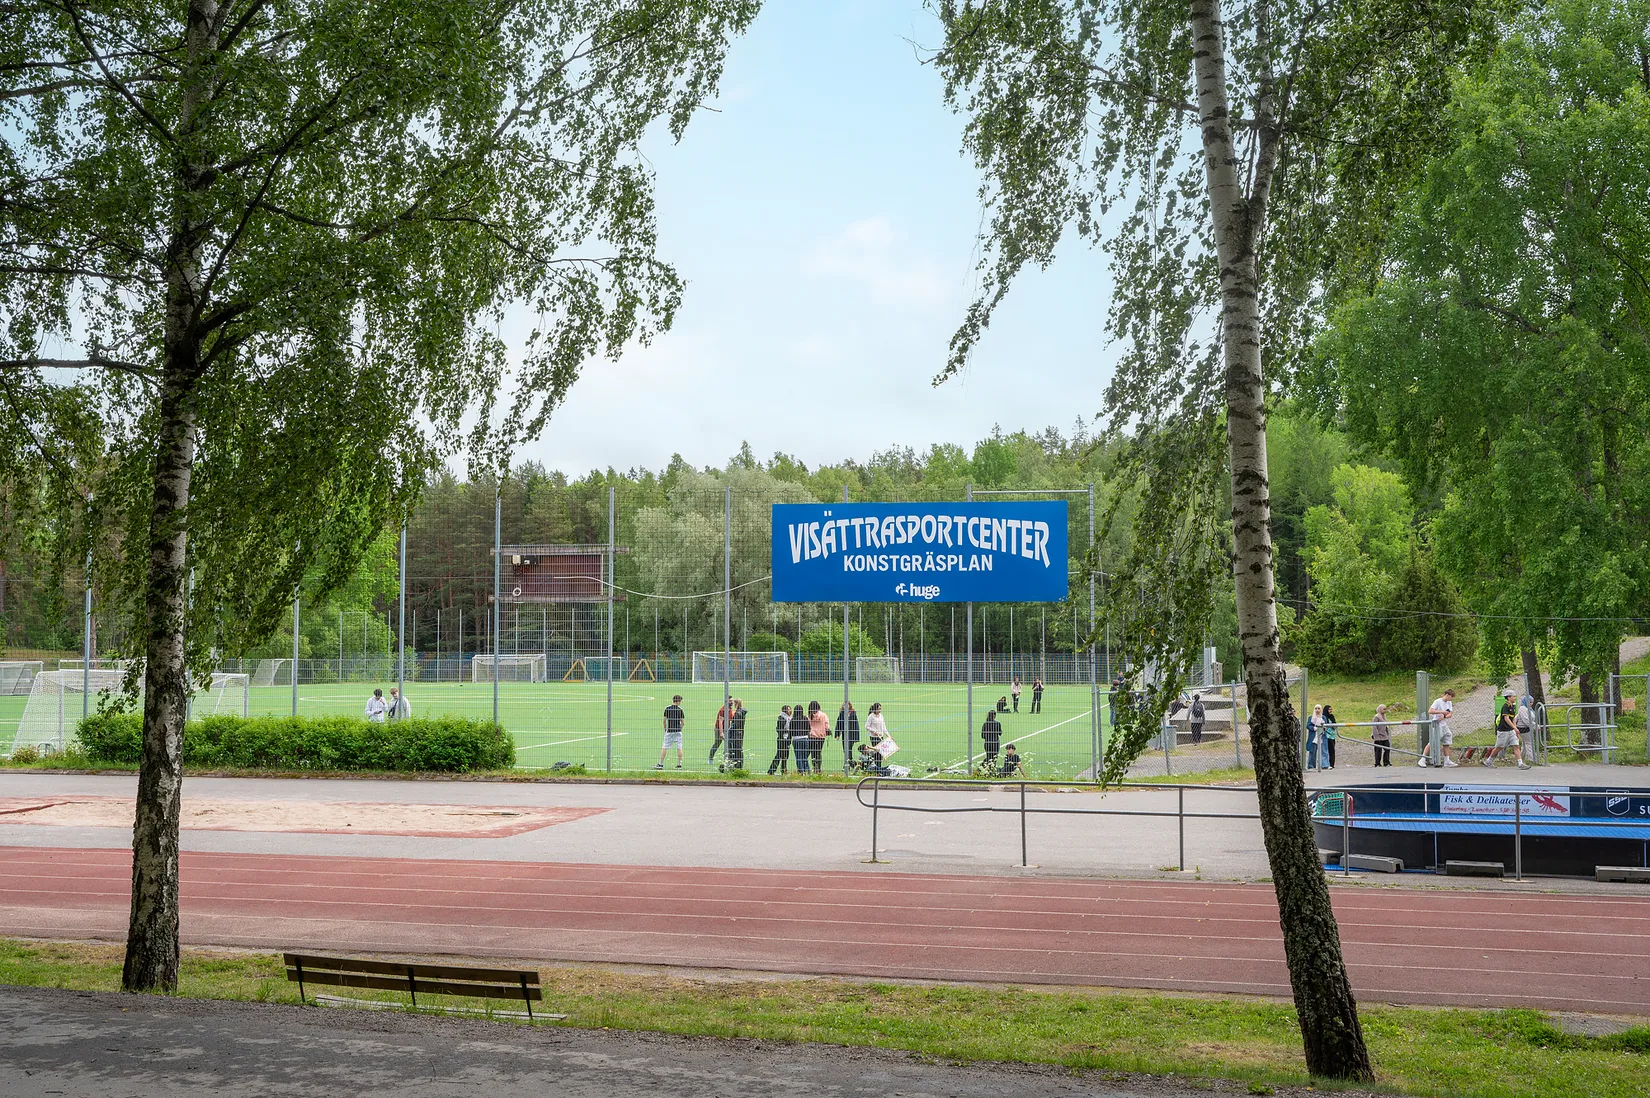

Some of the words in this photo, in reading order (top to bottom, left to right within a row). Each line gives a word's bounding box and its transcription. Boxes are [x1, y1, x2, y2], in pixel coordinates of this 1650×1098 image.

[843, 552, 993, 572] KONSTGRÄSPLAN
[909, 583, 940, 600] huge
[1444, 795, 1463, 804] Fisk
[1466, 795, 1473, 804] &
[1477, 795, 1530, 805] Delikateser
